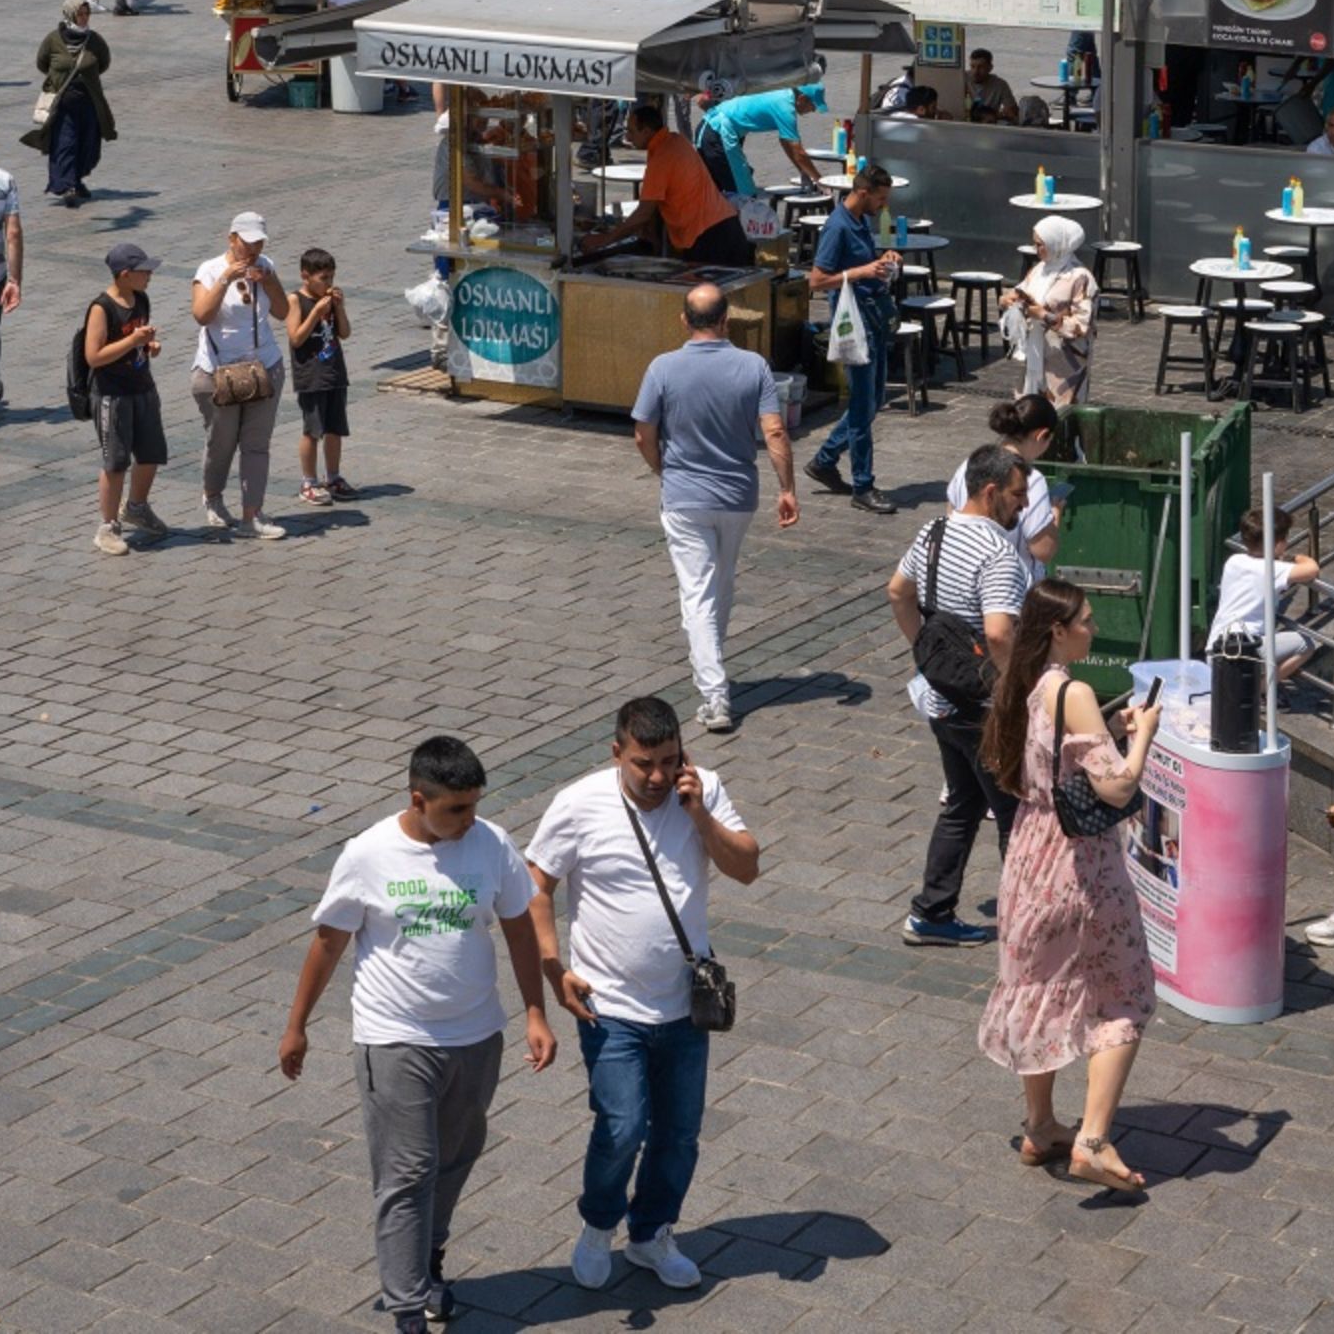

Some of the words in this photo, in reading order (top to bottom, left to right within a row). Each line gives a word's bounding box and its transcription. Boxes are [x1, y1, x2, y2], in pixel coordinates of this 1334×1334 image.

[380, 40, 489, 75] OSMANLI
[504, 52, 613, 87] LOKMASI
[458, 281, 552, 315] OSMANLI
[461, 316, 549, 350] LOKMASI
[386, 878, 428, 898] GOOD
[438, 888, 478, 907] TIME
[394, 898, 469, 926] Trust
